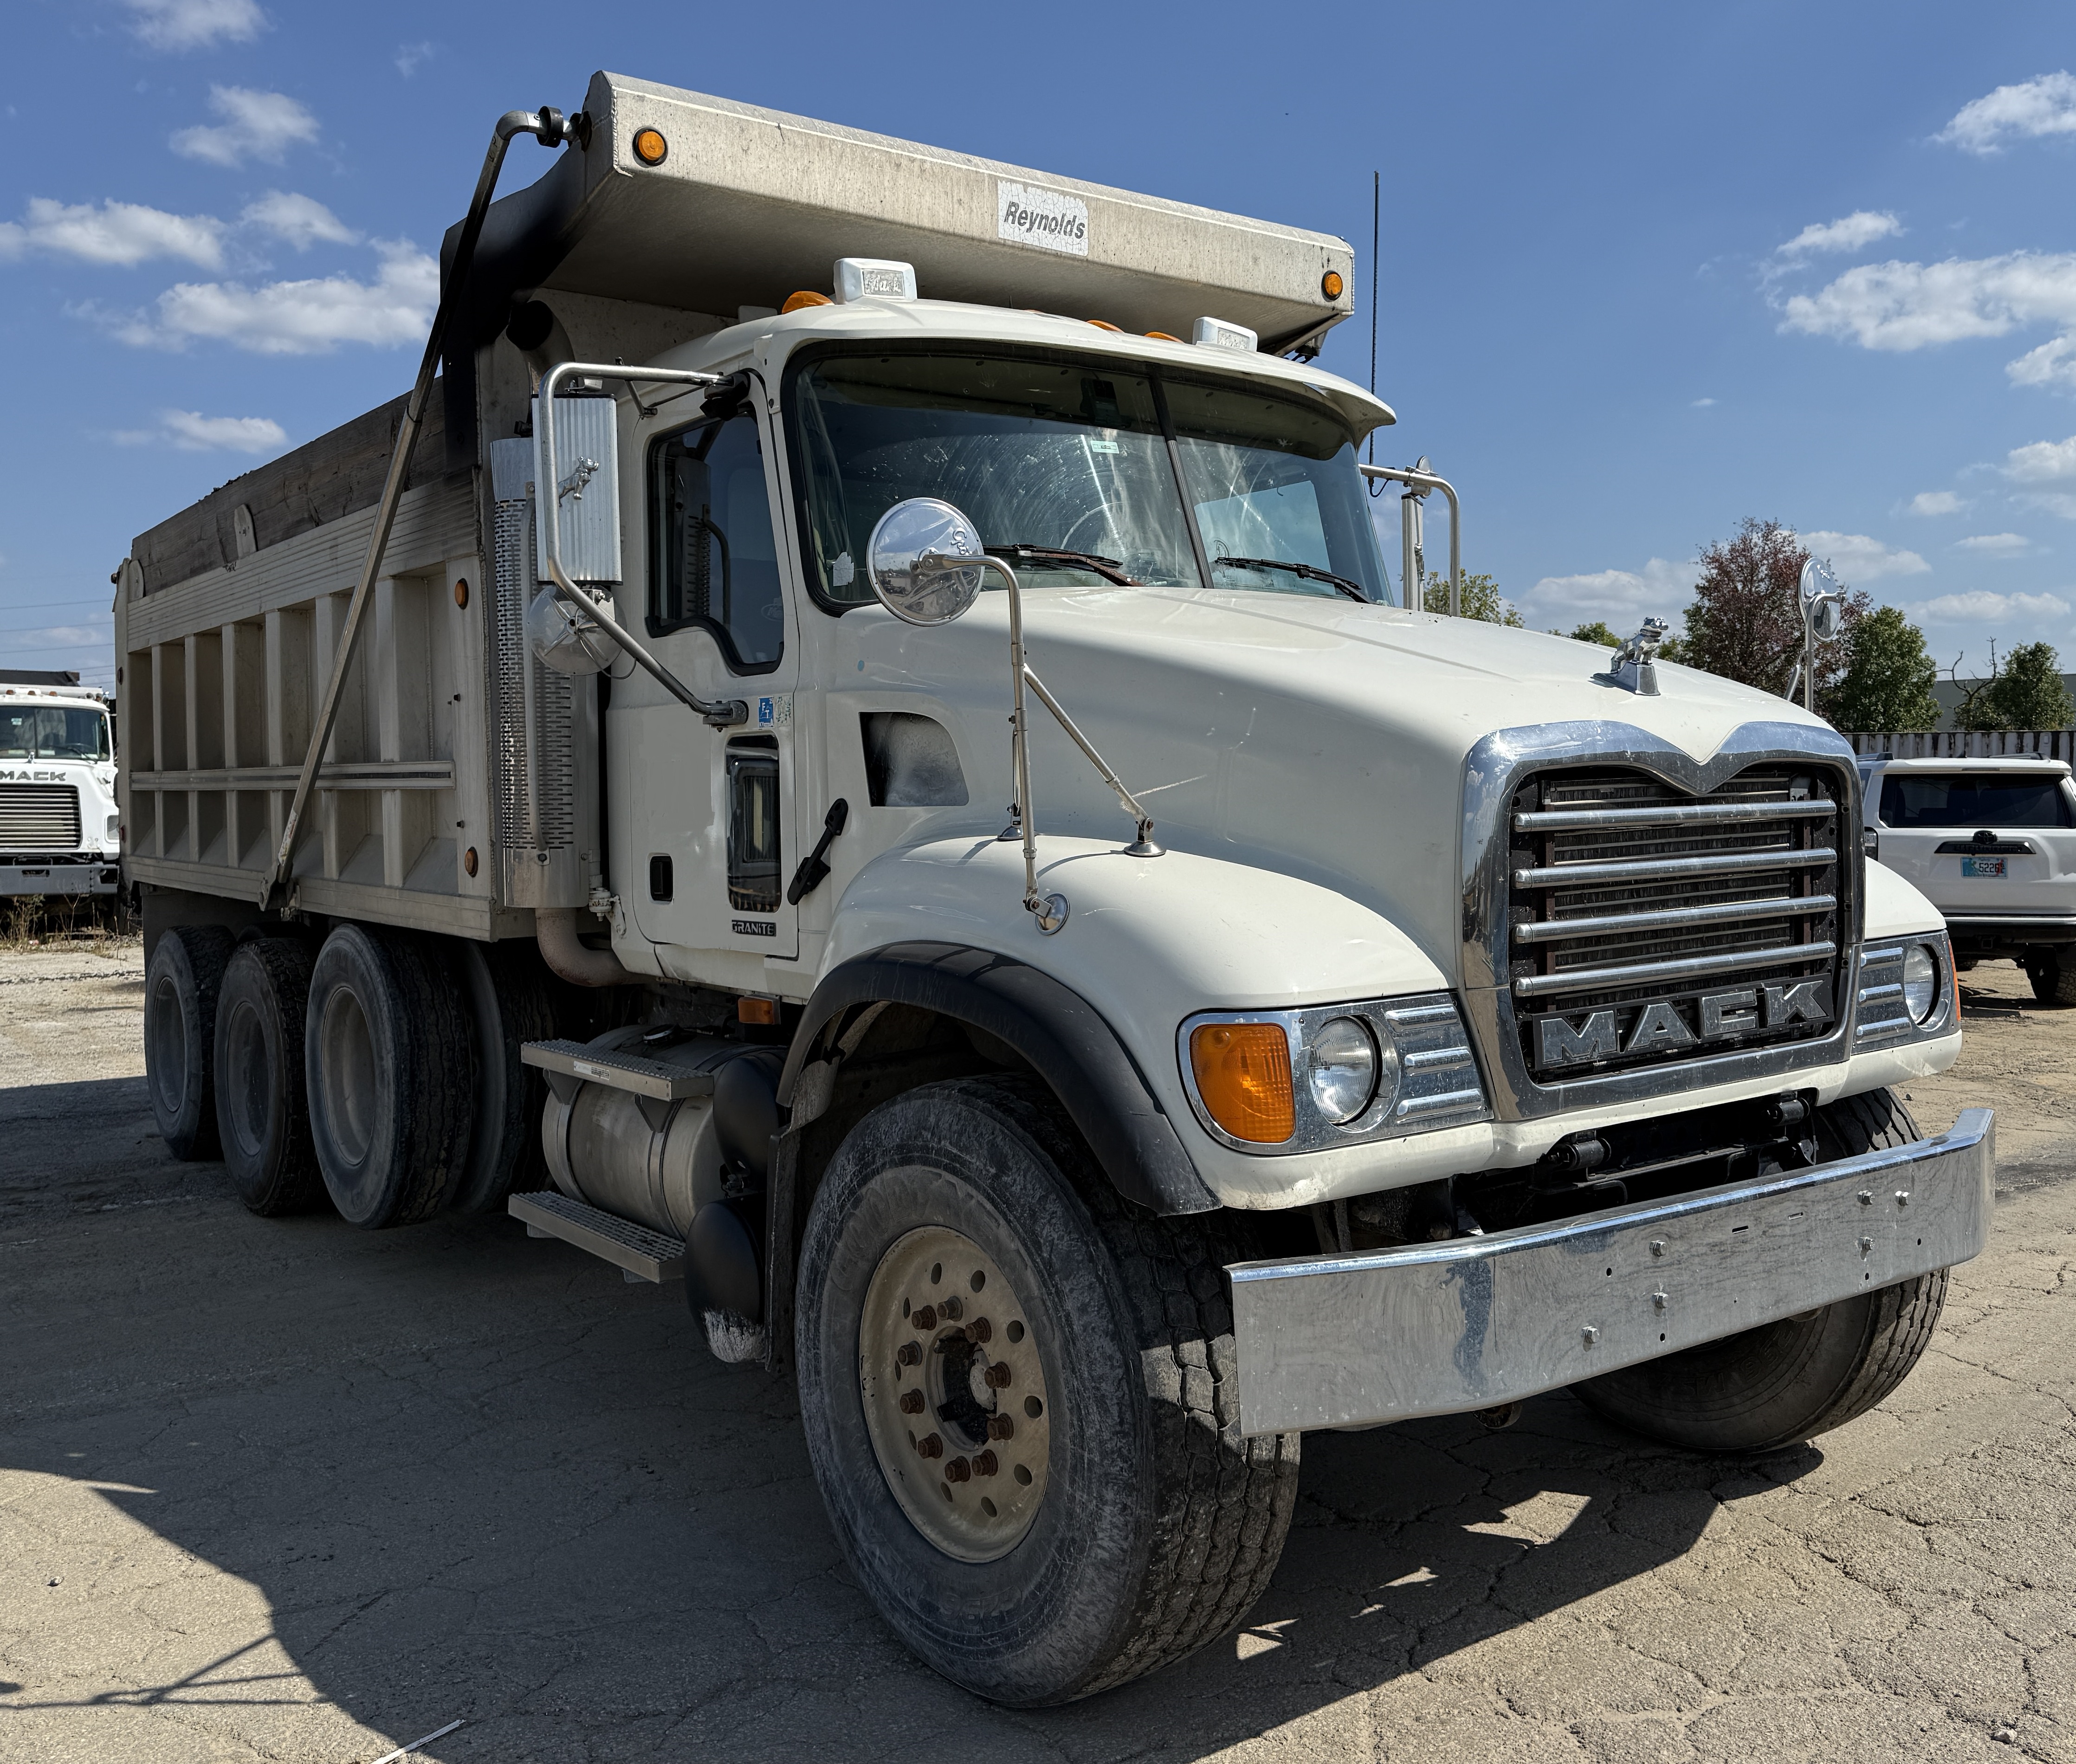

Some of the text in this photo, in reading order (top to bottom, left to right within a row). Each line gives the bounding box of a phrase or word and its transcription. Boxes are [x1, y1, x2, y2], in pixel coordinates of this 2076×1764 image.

[1004, 201, 1085, 239] Reynolds
[0, 770, 66, 782] MACK
[732, 921, 774, 935] GRANITE
[1540, 980, 1830, 1063] MACK
